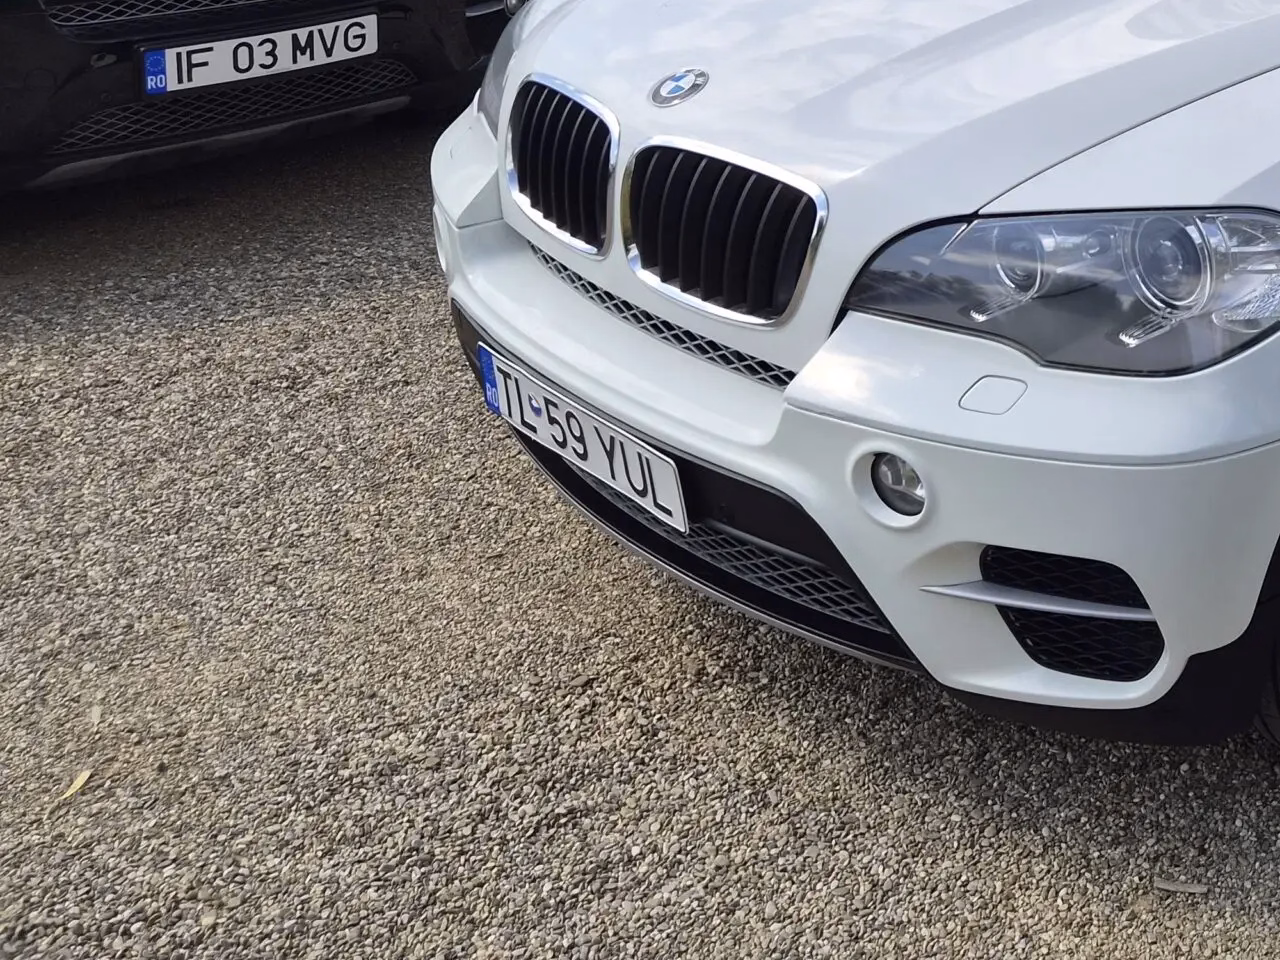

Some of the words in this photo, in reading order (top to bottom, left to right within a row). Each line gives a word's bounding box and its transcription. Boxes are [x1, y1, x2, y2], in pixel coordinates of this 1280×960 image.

[175, 46, 214, 85] IF
[232, 37, 278, 74] 03
[291, 21, 367, 65] MVG
[147, 74, 166, 90] RO
[485, 383, 500, 407] RO
[496, 364, 538, 435] TL
[543, 395, 589, 462] 59
[594, 425, 674, 519] YUL
